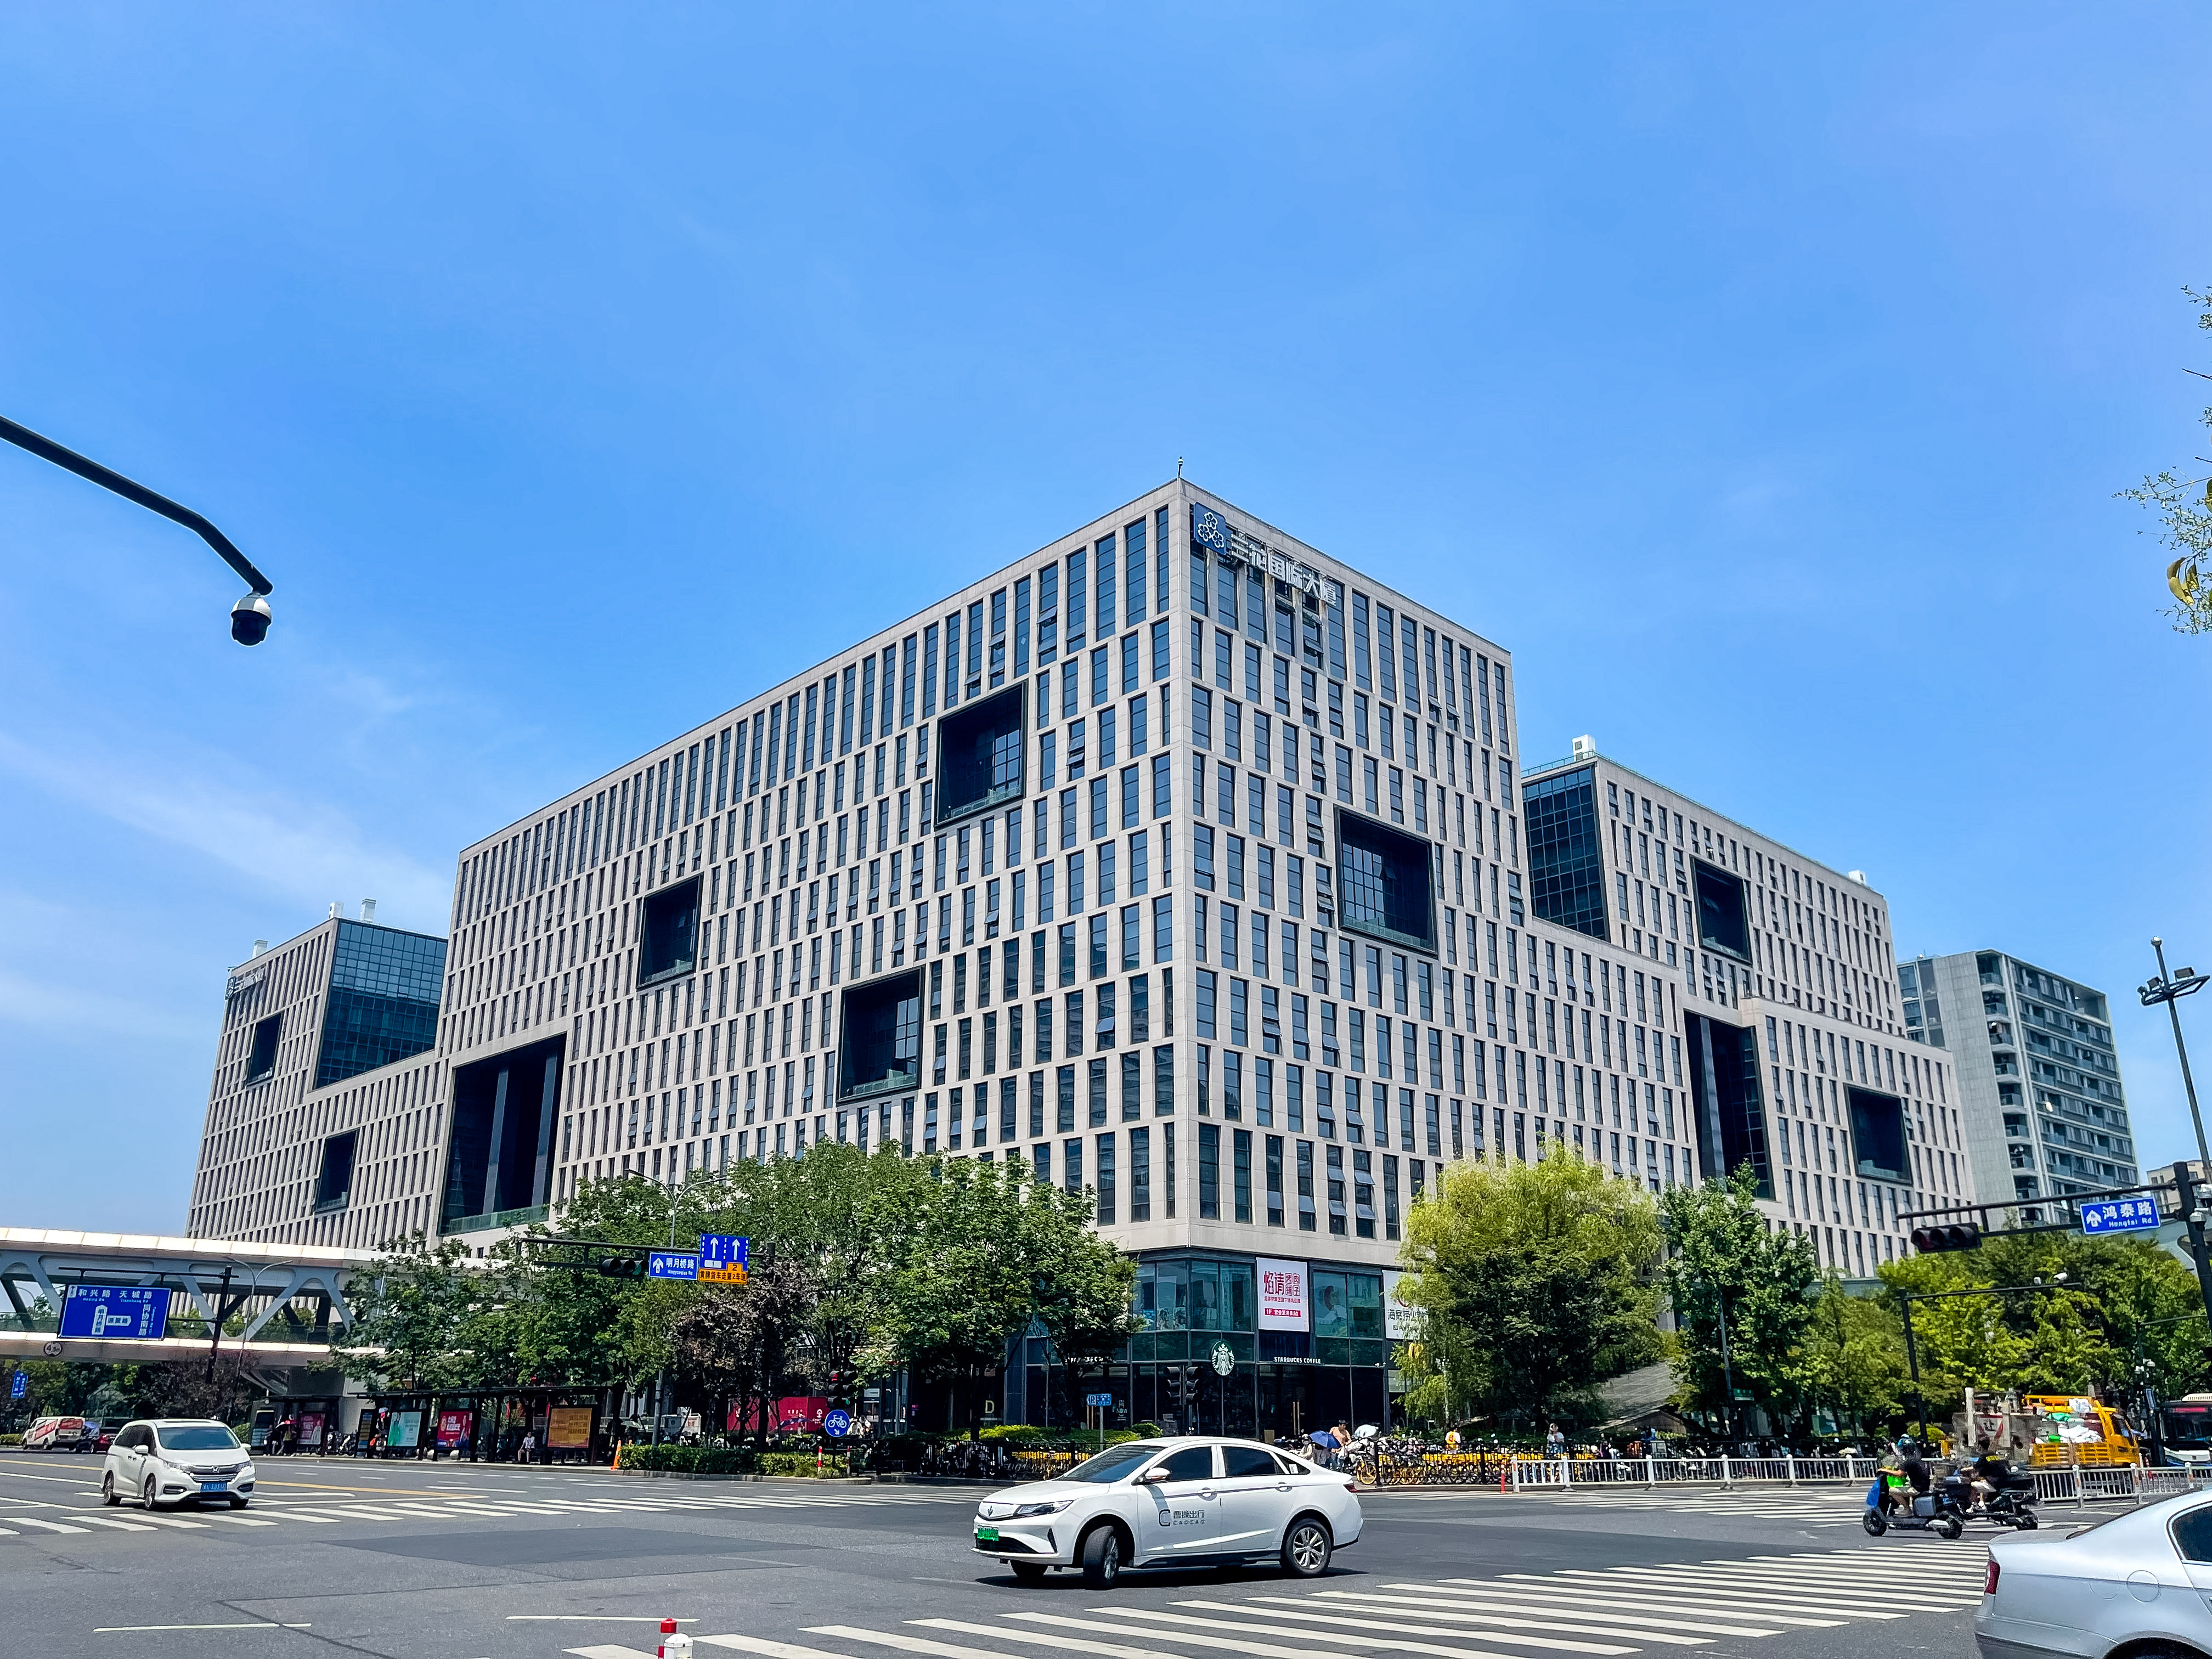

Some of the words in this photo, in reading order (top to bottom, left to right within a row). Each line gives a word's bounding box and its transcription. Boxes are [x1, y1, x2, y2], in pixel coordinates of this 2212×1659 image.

[1231, 532, 1338, 606] 三花国际大厦
[2102, 1200, 2152, 1220] 鸿泰路
[665, 1257, 695, 1269] 明月桥路
[699, 1271, 747, 1282] 黄牌货车走第2车道
[78, 1289, 111, 1298] 和兴路
[119, 1290, 153, 1299] 天城路
[985, 1400, 995, 1414] D
[1173, 1510, 1205, 1519] 曹操出行
